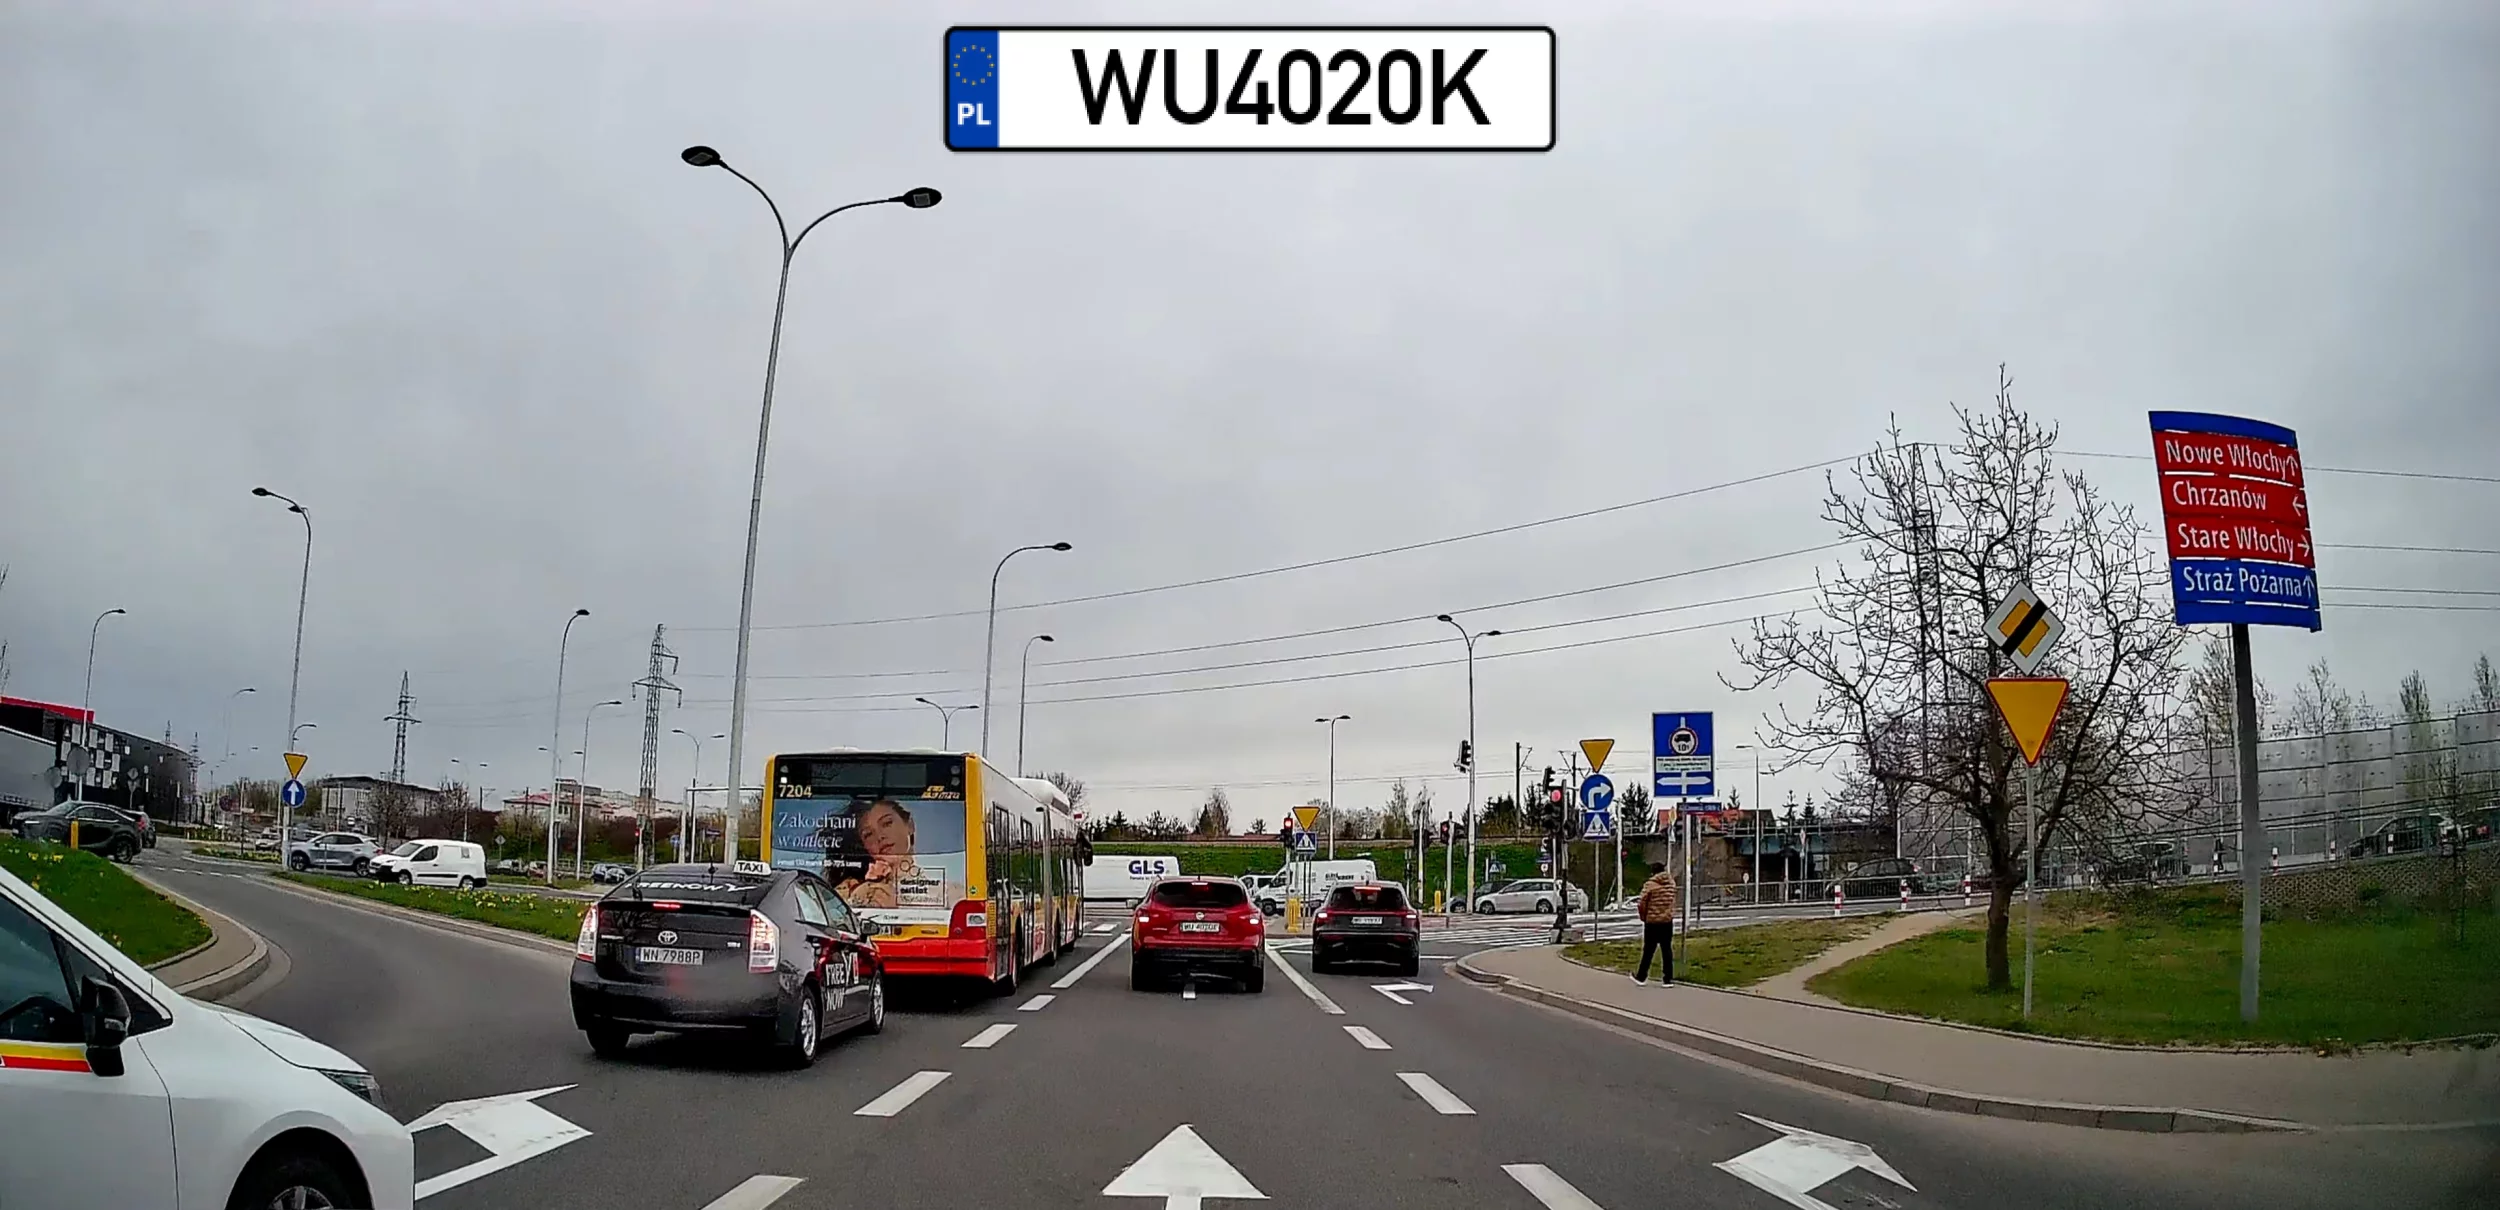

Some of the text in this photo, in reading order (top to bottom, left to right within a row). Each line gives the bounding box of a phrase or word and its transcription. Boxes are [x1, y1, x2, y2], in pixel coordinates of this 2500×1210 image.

[2165, 440, 2286, 480] Nowe Włochy
[2173, 480, 2267, 510] Chrzanów
[2178, 523, 2294, 562] Stare Włochy
[2183, 566, 2303, 598] Straż Pożarna
[778, 785, 812, 798] 7204
[778, 812, 856, 828] Zakochani
[777, 837, 791, 847] w
[738, 862, 763, 872] TAXI
[1128, 860, 1165, 875] GLS
[643, 948, 701, 962] WN 7988P
[826, 963, 844, 986] FREE
[826, 987, 845, 1012] NOW
